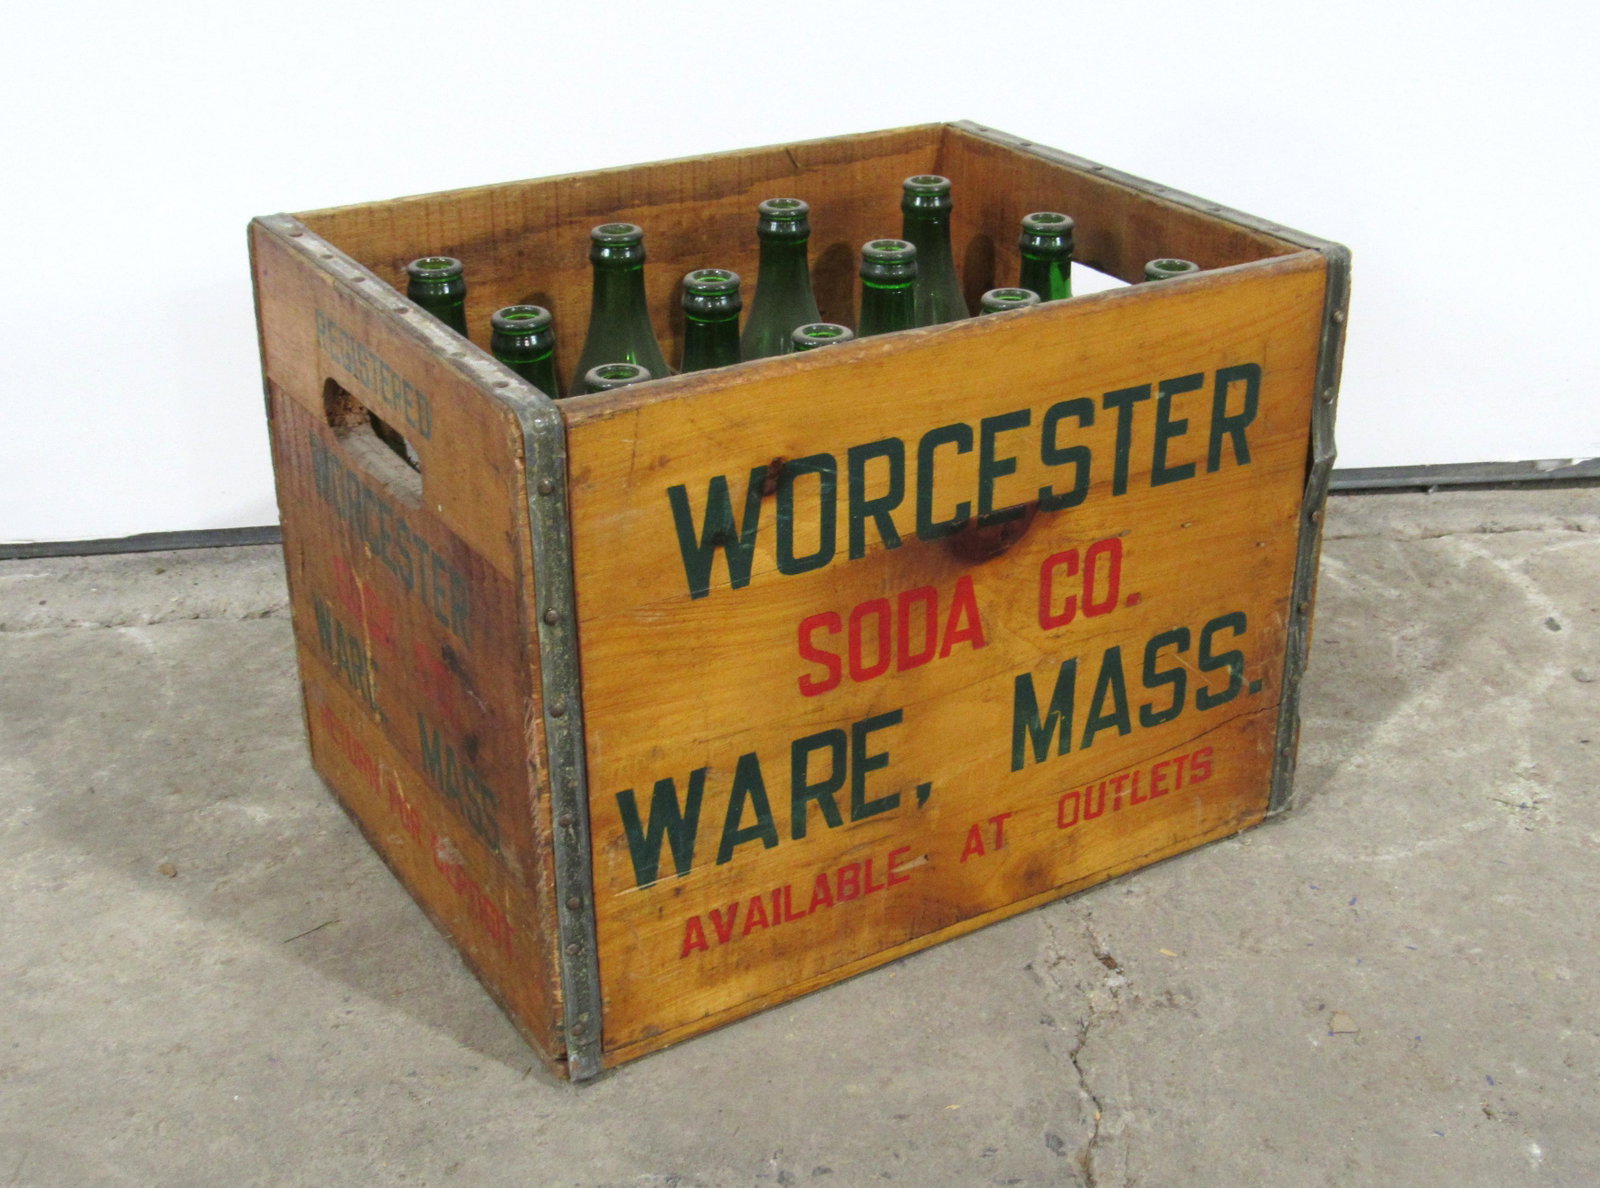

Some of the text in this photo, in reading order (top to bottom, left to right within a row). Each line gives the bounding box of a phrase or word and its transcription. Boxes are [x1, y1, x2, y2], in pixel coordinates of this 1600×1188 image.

[667, 362, 1262, 601] WORCESTER
[797, 537, 1142, 699] SODA CO.
[614, 610, 1264, 893] WARE, MASS.
[680, 746, 1215, 960] AVAILABLE AT OUTLETS
